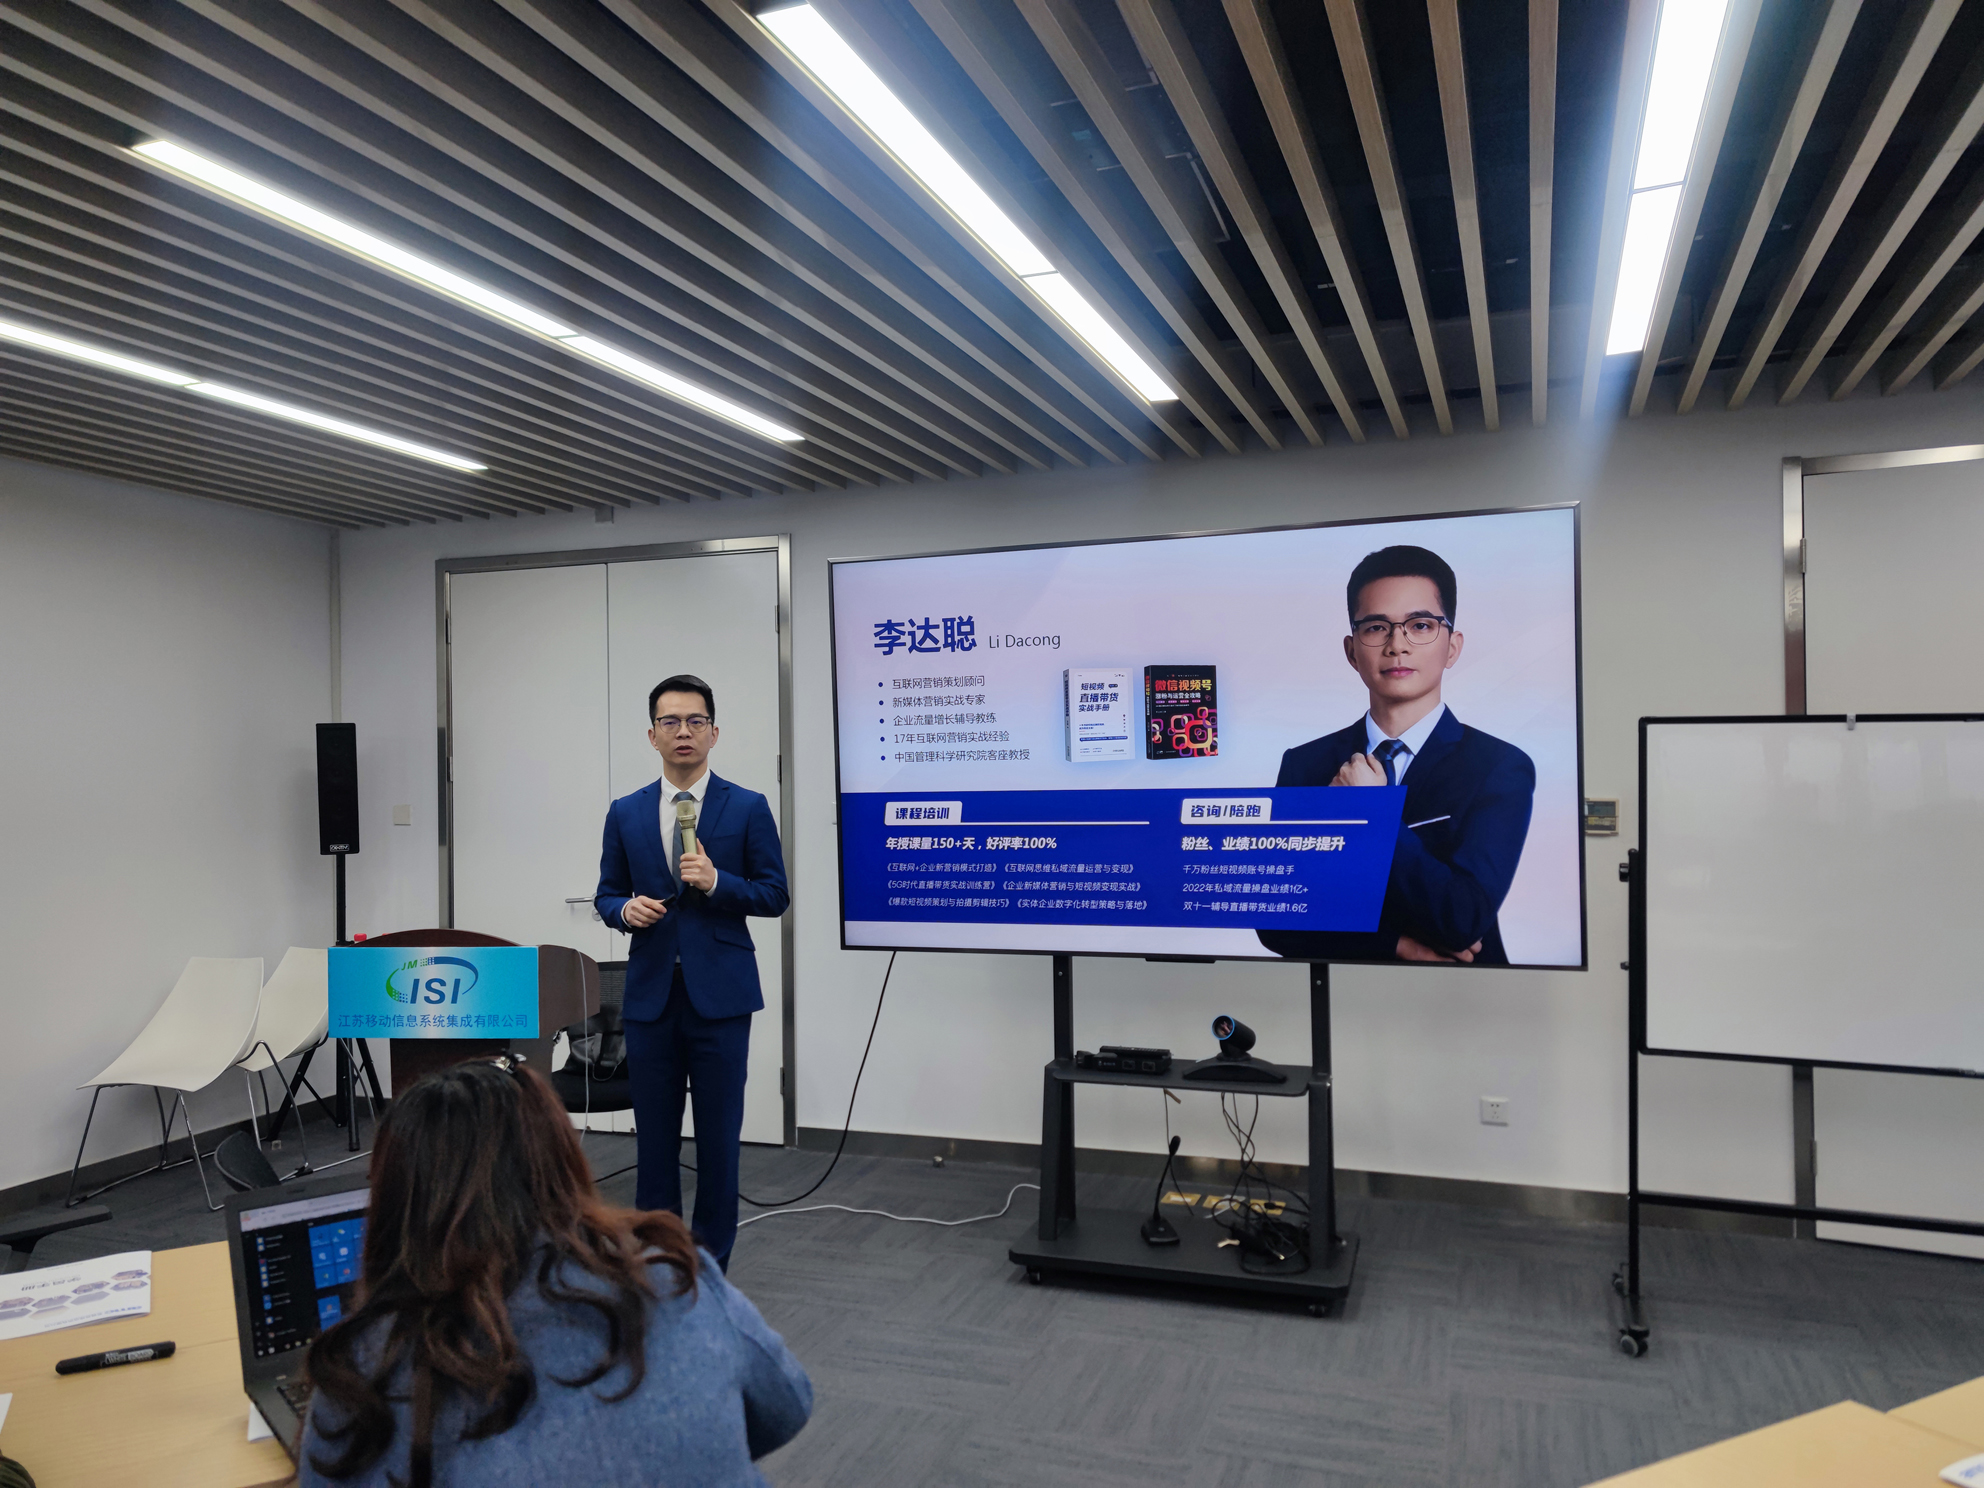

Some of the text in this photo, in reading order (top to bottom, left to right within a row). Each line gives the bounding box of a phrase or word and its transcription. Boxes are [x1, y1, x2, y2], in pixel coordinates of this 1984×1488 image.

[873, 615, 977, 656] 李达聪
[989, 634, 1061, 649] Li Dacong
[892, 675, 985, 690] 互联网营销策划顾问
[1080, 683, 1105, 691] 短视频
[1154, 679, 1212, 691] 微信视频号
[892, 694, 986, 708] 新媒体营销实战专家
[1079, 693, 1119, 703] 直播带货
[1078, 703, 1110, 713] 实战手册
[893, 712, 997, 727] 企业流量增长辅导教练
[894, 731, 1010, 744] 17年互联网营销实战经验
[894, 749, 1030, 763] 中国管理科学研究院客座教授
[895, 807, 950, 820] 课程培训
[1190, 804, 1261, 818] 咨询/陪跑
[1181, 836, 1345, 851] 粉丝、业绩100%同步提升
[1182, 865, 1295, 875] 千万粉丝短视频账号操盘手
[1182, 883, 1308, 894] 2022年私域流量操盘业绩1亿+
[1183, 902, 1308, 913] 双十一辅导直播带货业绩1.6亿
[401, 959, 418, 971] JM
[410, 978, 461, 1005] ISI
[338, 1014, 528, 1028] 江苏移动信息系统集成有限公司
